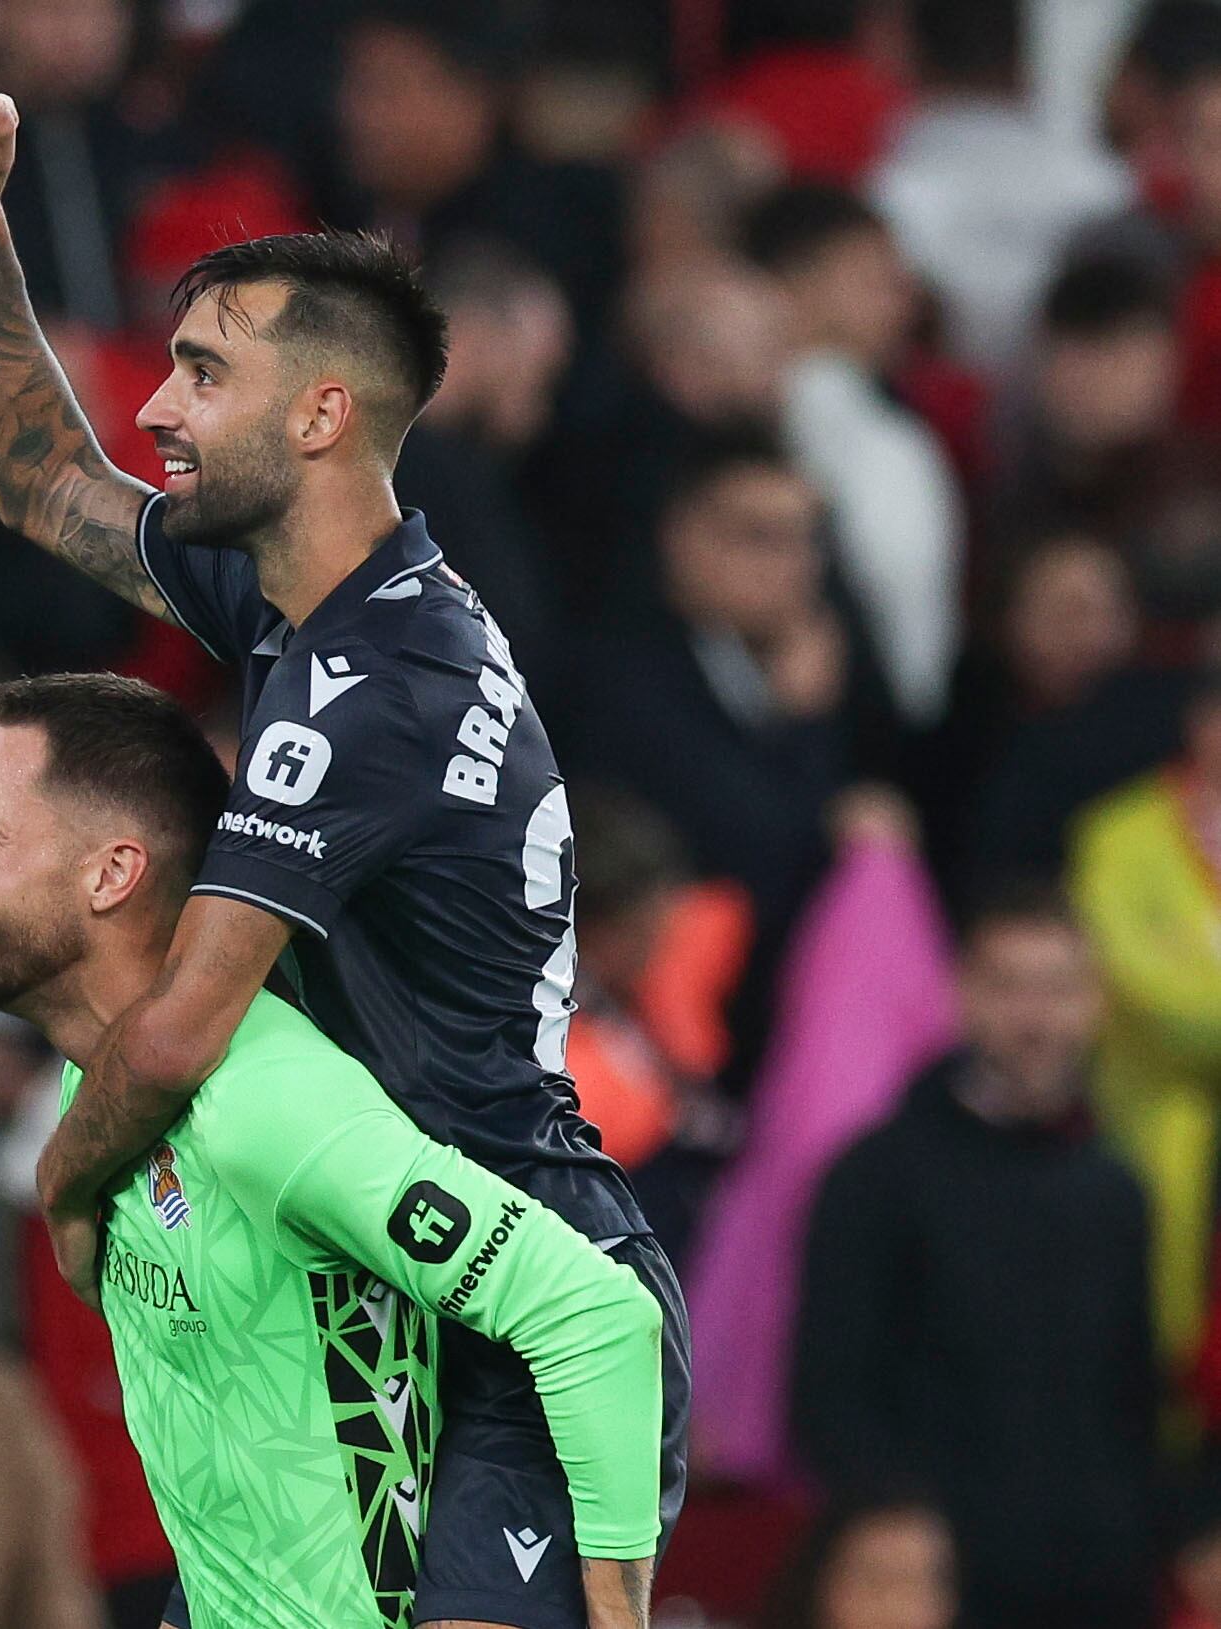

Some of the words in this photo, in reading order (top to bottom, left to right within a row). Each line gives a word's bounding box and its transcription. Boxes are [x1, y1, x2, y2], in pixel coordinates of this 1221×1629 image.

[266, 741, 311, 788] fi
[408, 1199, 456, 1247] fi
[438, 1200, 527, 1316] finetwork
[168, 1319, 207, 1338] group
